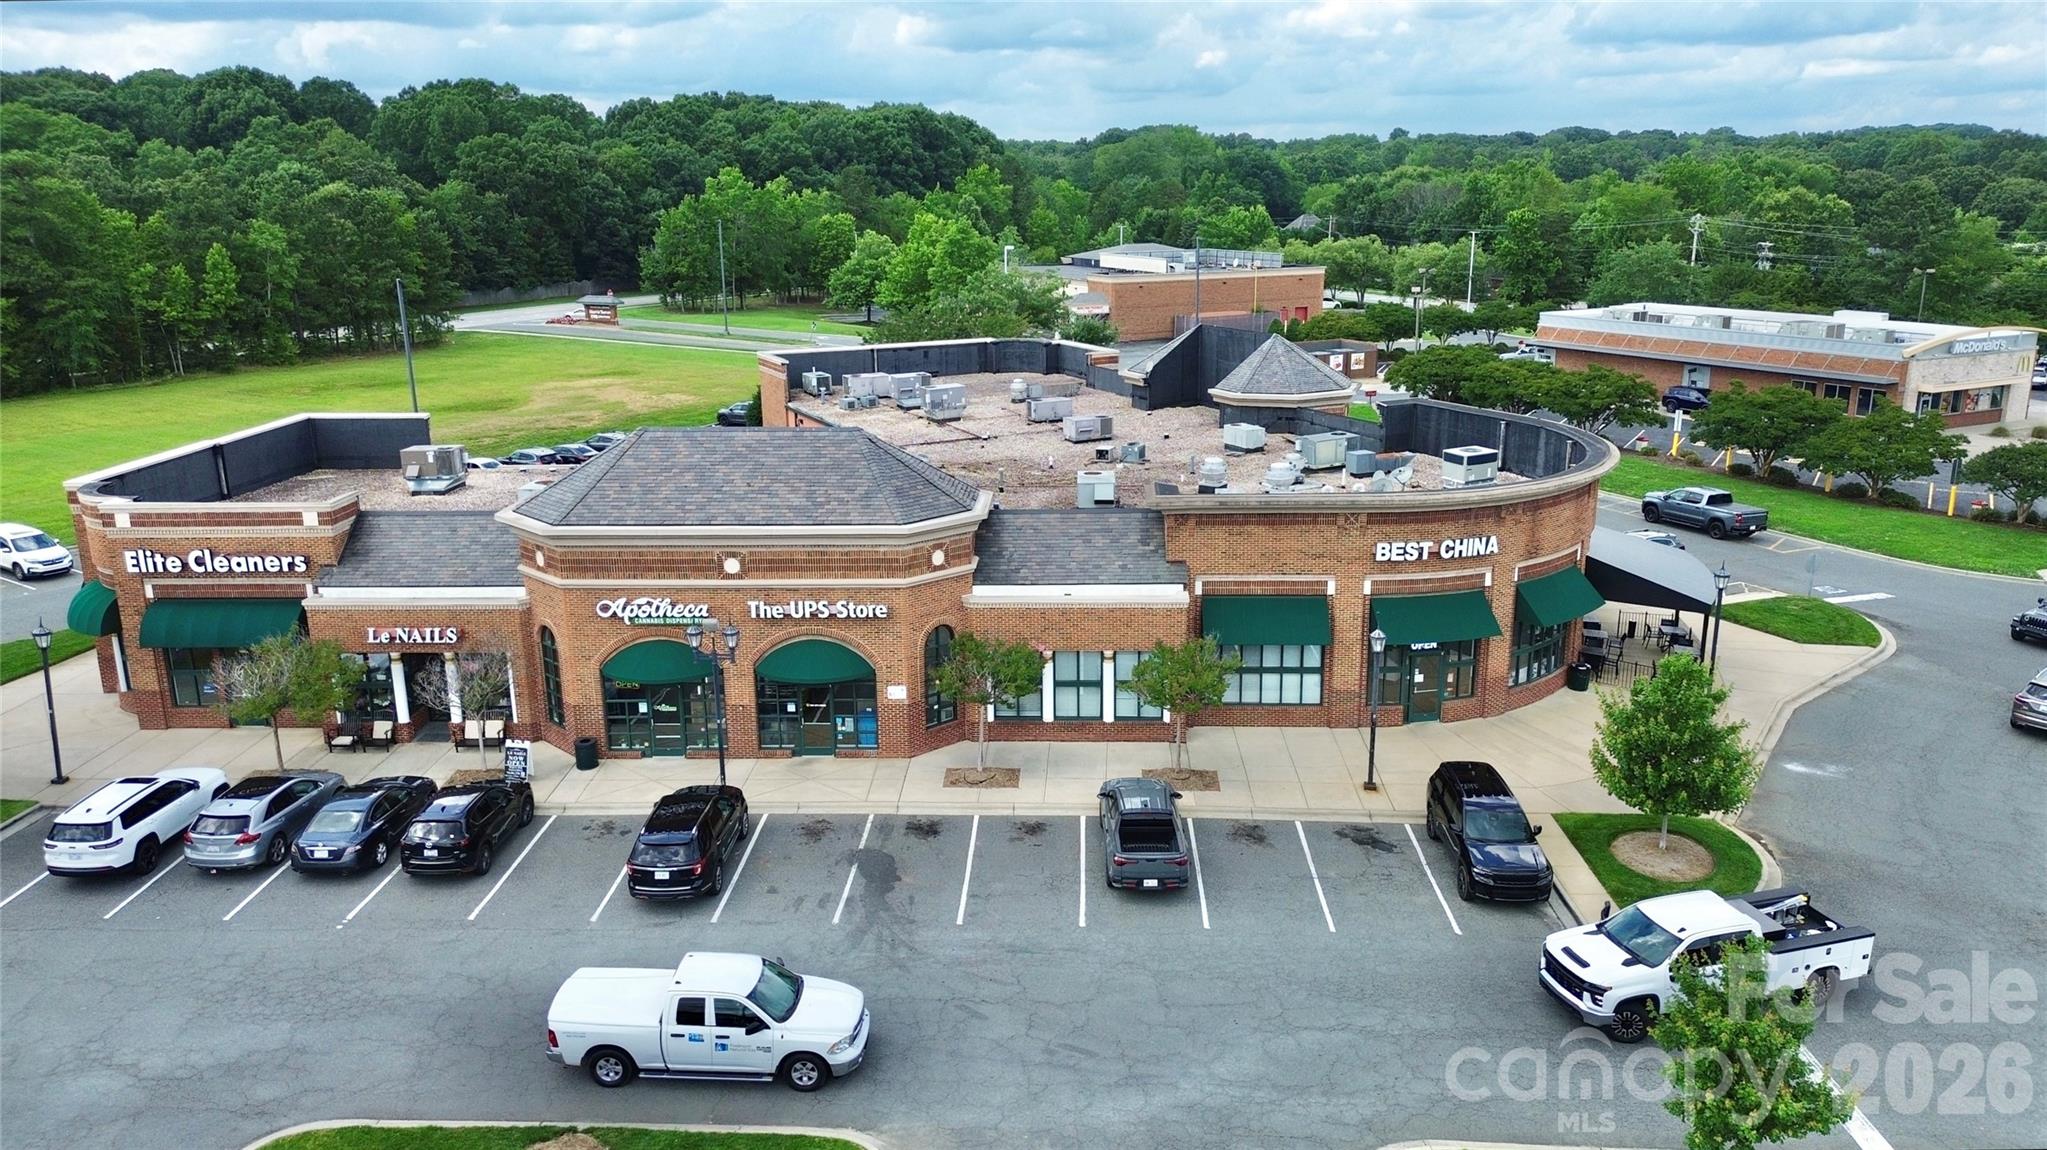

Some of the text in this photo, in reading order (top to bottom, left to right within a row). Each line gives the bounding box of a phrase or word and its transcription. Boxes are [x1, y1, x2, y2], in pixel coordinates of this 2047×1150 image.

[1953, 339, 2006, 354] McDonald's
[1375, 535, 1499, 562] BEST CHINA
[124, 549, 307, 573] Elite Cleaners
[596, 597, 710, 625] Apotheca
[747, 600, 888, 619] The UPS Store
[366, 626, 457, 643] Le NAILS
